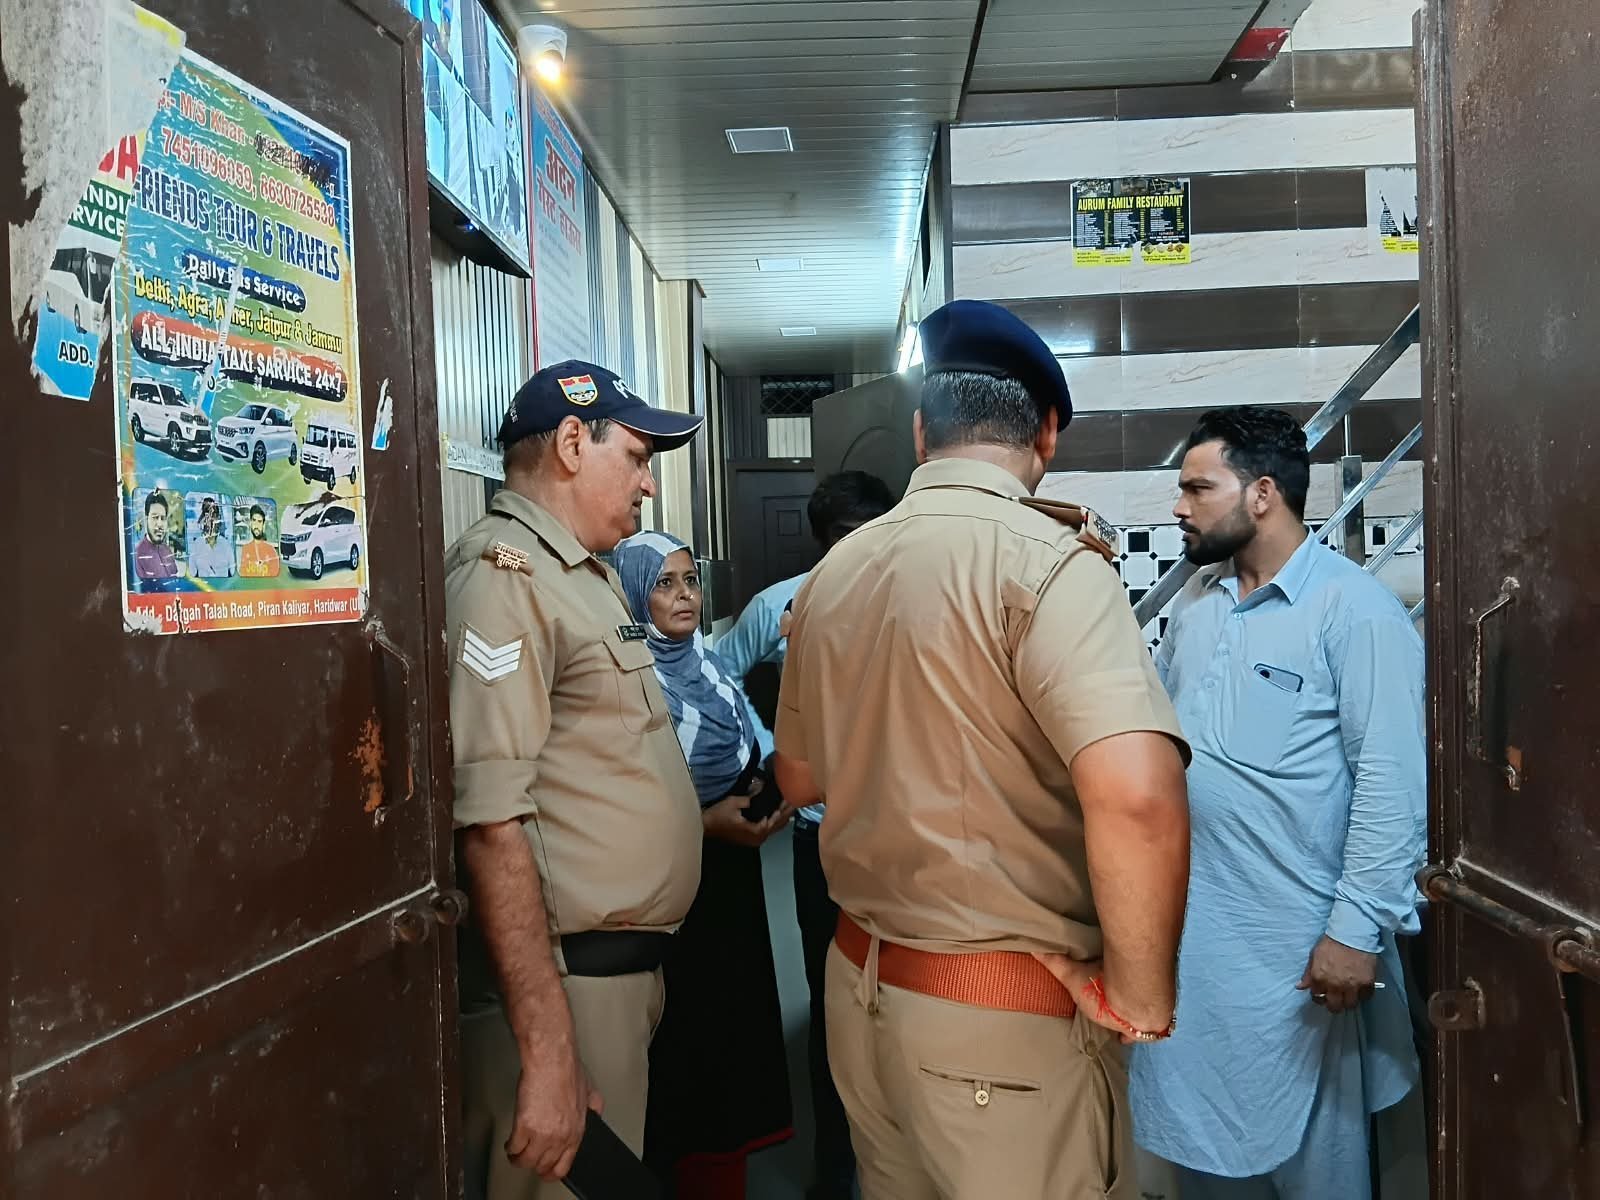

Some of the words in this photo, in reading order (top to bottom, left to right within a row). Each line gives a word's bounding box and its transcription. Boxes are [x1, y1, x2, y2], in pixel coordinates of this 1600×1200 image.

[210, 106, 246, 146] Khan
[69, 204, 126, 237] RVICE
[129, 164, 210, 234] FRIENDS
[212, 194, 258, 251] TOUR
[262, 216, 275, 257] &
[276, 222, 341, 283] TRAVELS
[260, 172, 335, 229] 8630725538
[1077, 198, 1105, 211] AURUM
[1107, 196, 1134, 209] FAMILY
[1136, 194, 1184, 208] RESTAURANT
[188, 254, 224, 284] Daily
[227, 267, 251, 290] Bs
[254, 276, 301, 306] Service
[135, 272, 174, 312] Delhi,
[178, 284, 213, 323] Agra,
[256, 307, 293, 341] Jaipur
[294, 318, 304, 343] &
[304, 323, 343, 354] Jammu
[59, 341, 93, 367] ADD.
[141, 323, 171, 354] ALL
[175, 332, 216, 363] INDIA
[222, 343, 255, 373] TAXI
[257, 352, 312, 387] SARVICE
[203, 603, 227, 620] Talab
[230, 602, 255, 619] Road,
[258, 600, 281, 617] Piran
[282, 599, 312, 617] Kaliyar,
[314, 597, 347, 613] Haridwar
